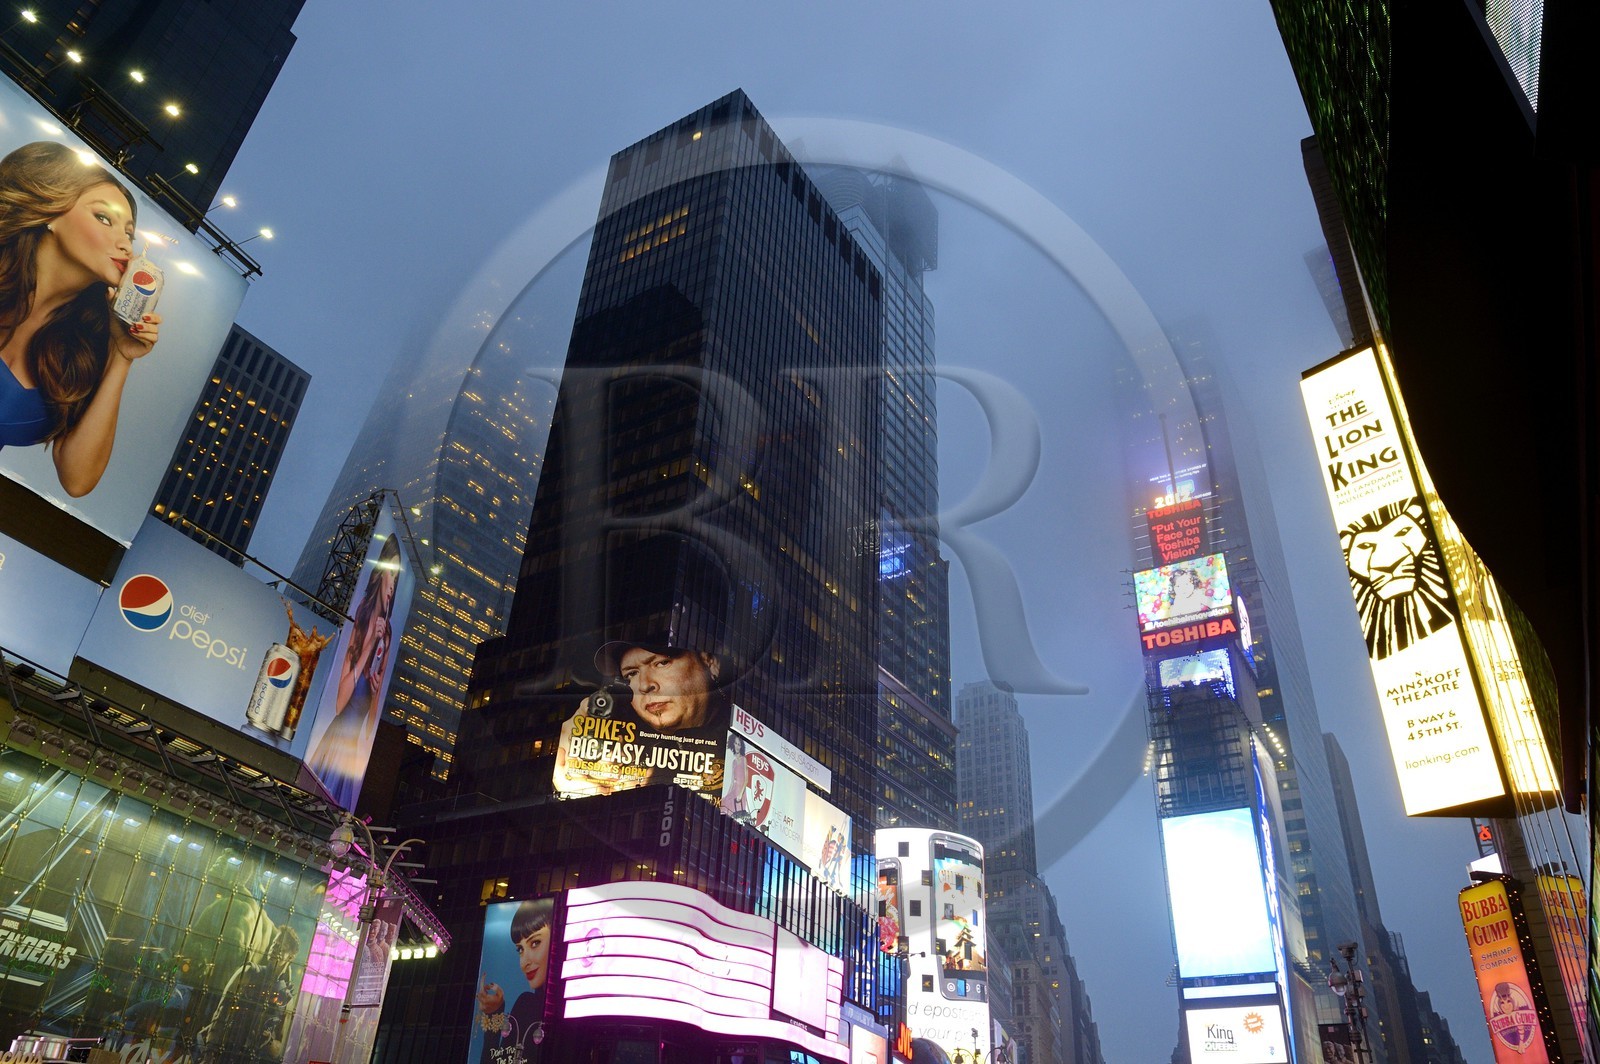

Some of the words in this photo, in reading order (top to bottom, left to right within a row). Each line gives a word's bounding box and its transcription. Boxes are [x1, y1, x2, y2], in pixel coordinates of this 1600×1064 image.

[1326, 400, 1368, 428] THE
[1324, 418, 1383, 460] LION
[1327, 446, 1398, 492] KING
[1146, 499, 1202, 519] TOSHIBA
[1176, 516, 1201, 528] Your
[1157, 531, 1183, 544] Face
[1185, 527, 1200, 536] on
[1158, 537, 1201, 552] Toshiba
[180, 605, 210, 625] diet
[1142, 618, 1236, 649] TOSHIBA
[169, 620, 247, 669] pepsi
[1386, 667, 1461, 697] MINSKOFF
[1392, 680, 1460, 706] THEATRE
[1418, 712, 1445, 725] WAY
[1448, 709, 1456, 718] &
[640, 731, 660, 739] Bounty
[660, 733, 682, 742] hunting
[1407, 726, 1443, 741] 45TH
[1445, 721, 1463, 732] ST.
[569, 736, 600, 760] BIG
[601, 741, 645, 766] EASY
[645, 746, 716, 775] JUSTICE
[1405, 745, 1480, 770] lionking.com
[568, 759, 620, 774] TUESDAYS
[621, 765, 647, 777] 10PM
[673, 777, 704, 787] SPIKE
[659, 786, 674, 847] 1500
[783, 815, 794, 827] ART
[1462, 893, 1508, 923] BUBBA
[1472, 920, 1509, 946] GUMP
[1480, 955, 1518, 971] COMPANY
[1481, 946, 1512, 961] SHRIMP
[1491, 1013, 1516, 1032] BUBBA
[1515, 1011, 1536, 1025] GUMP
[897, 1021, 913, 1060] JVC
[919, 1027, 951, 1040] your
[1207, 1023, 1234, 1045] King
